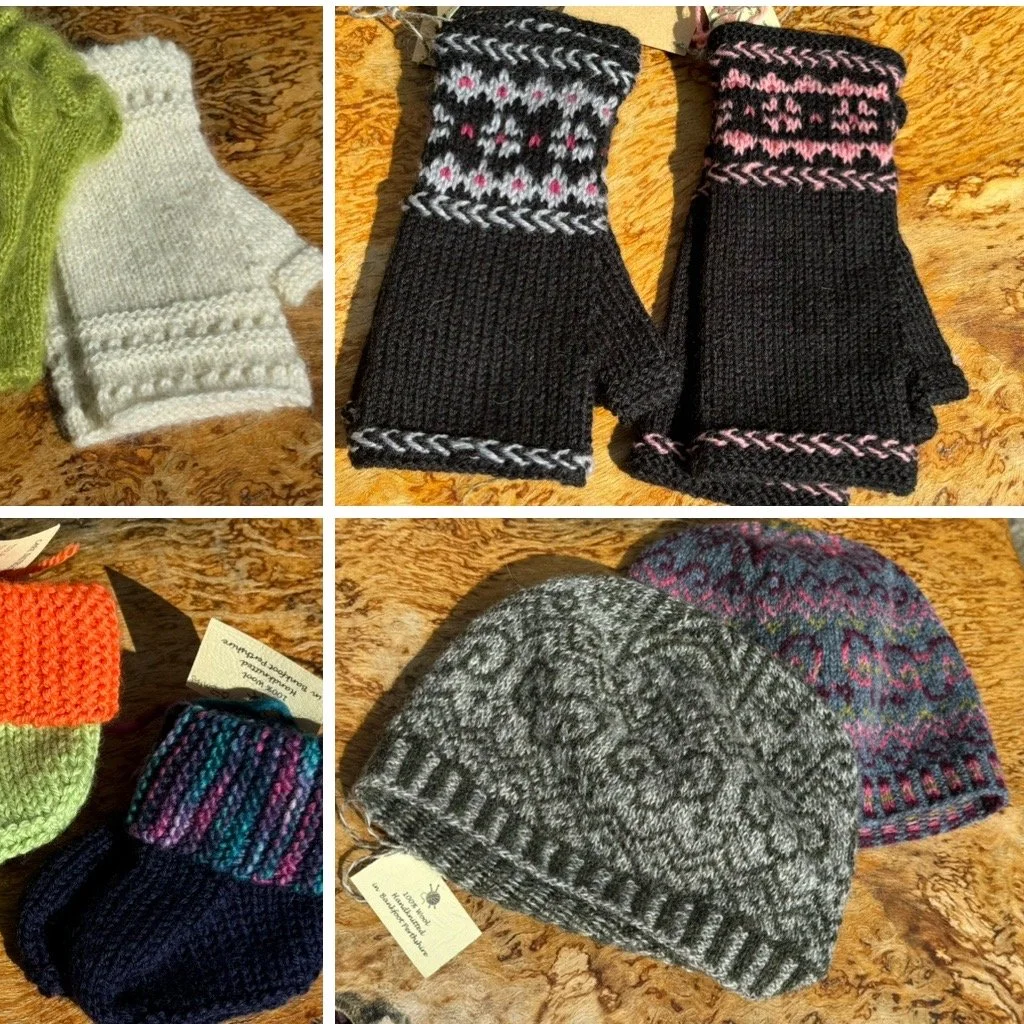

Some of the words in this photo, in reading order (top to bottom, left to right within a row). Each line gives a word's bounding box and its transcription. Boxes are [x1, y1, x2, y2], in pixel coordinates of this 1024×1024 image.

[221, 638, 268, 666] Perthshire
[239, 659, 297, 697] Handknitted
[242, 672, 264, 688] Wool
[268, 663, 308, 692] Bankfoot
[265, 685, 287, 702] 100%
[372, 882, 379, 892] in
[379, 892, 403, 924] Bankfoot
[402, 923, 428, 957] Perthshire
[391, 892, 426, 936] Handknitted
[403, 892, 416, 909] 100%
[416, 908, 431, 926] Wool
